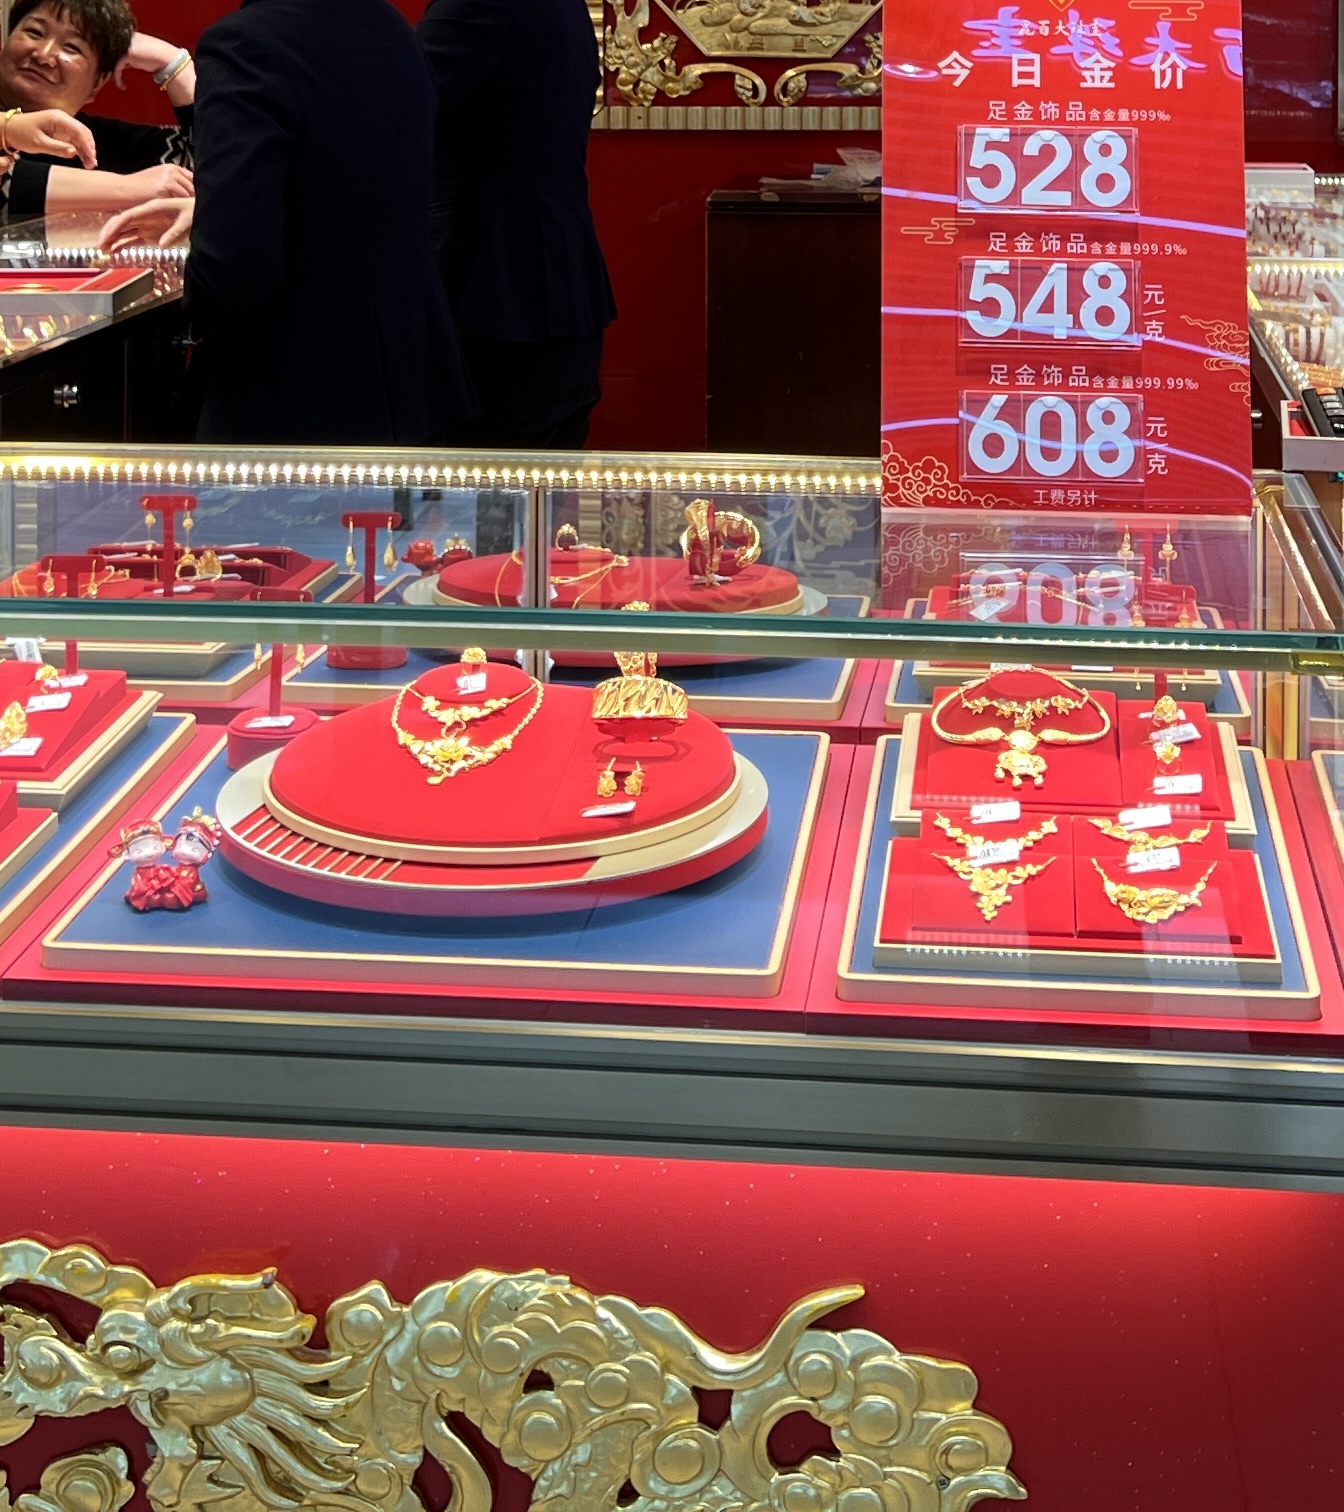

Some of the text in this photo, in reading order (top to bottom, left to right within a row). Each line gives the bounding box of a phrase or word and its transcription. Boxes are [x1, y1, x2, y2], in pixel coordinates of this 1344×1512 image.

[937, 50, 1188, 90] 今日金价
[987, 100, 1086, 122] 足金饰品
[966, 128, 1131, 207] 528
[988, 232, 1087, 254] 足金饰品
[966, 259, 1131, 341] 548
[1142, 284, 1167, 341] 元/克
[988, 364, 1090, 387] 足金饰品
[968, 394, 1136, 478] 608
[1145, 416, 1169, 475] 元/克
[1033, 489, 1099, 506] 工费另计
